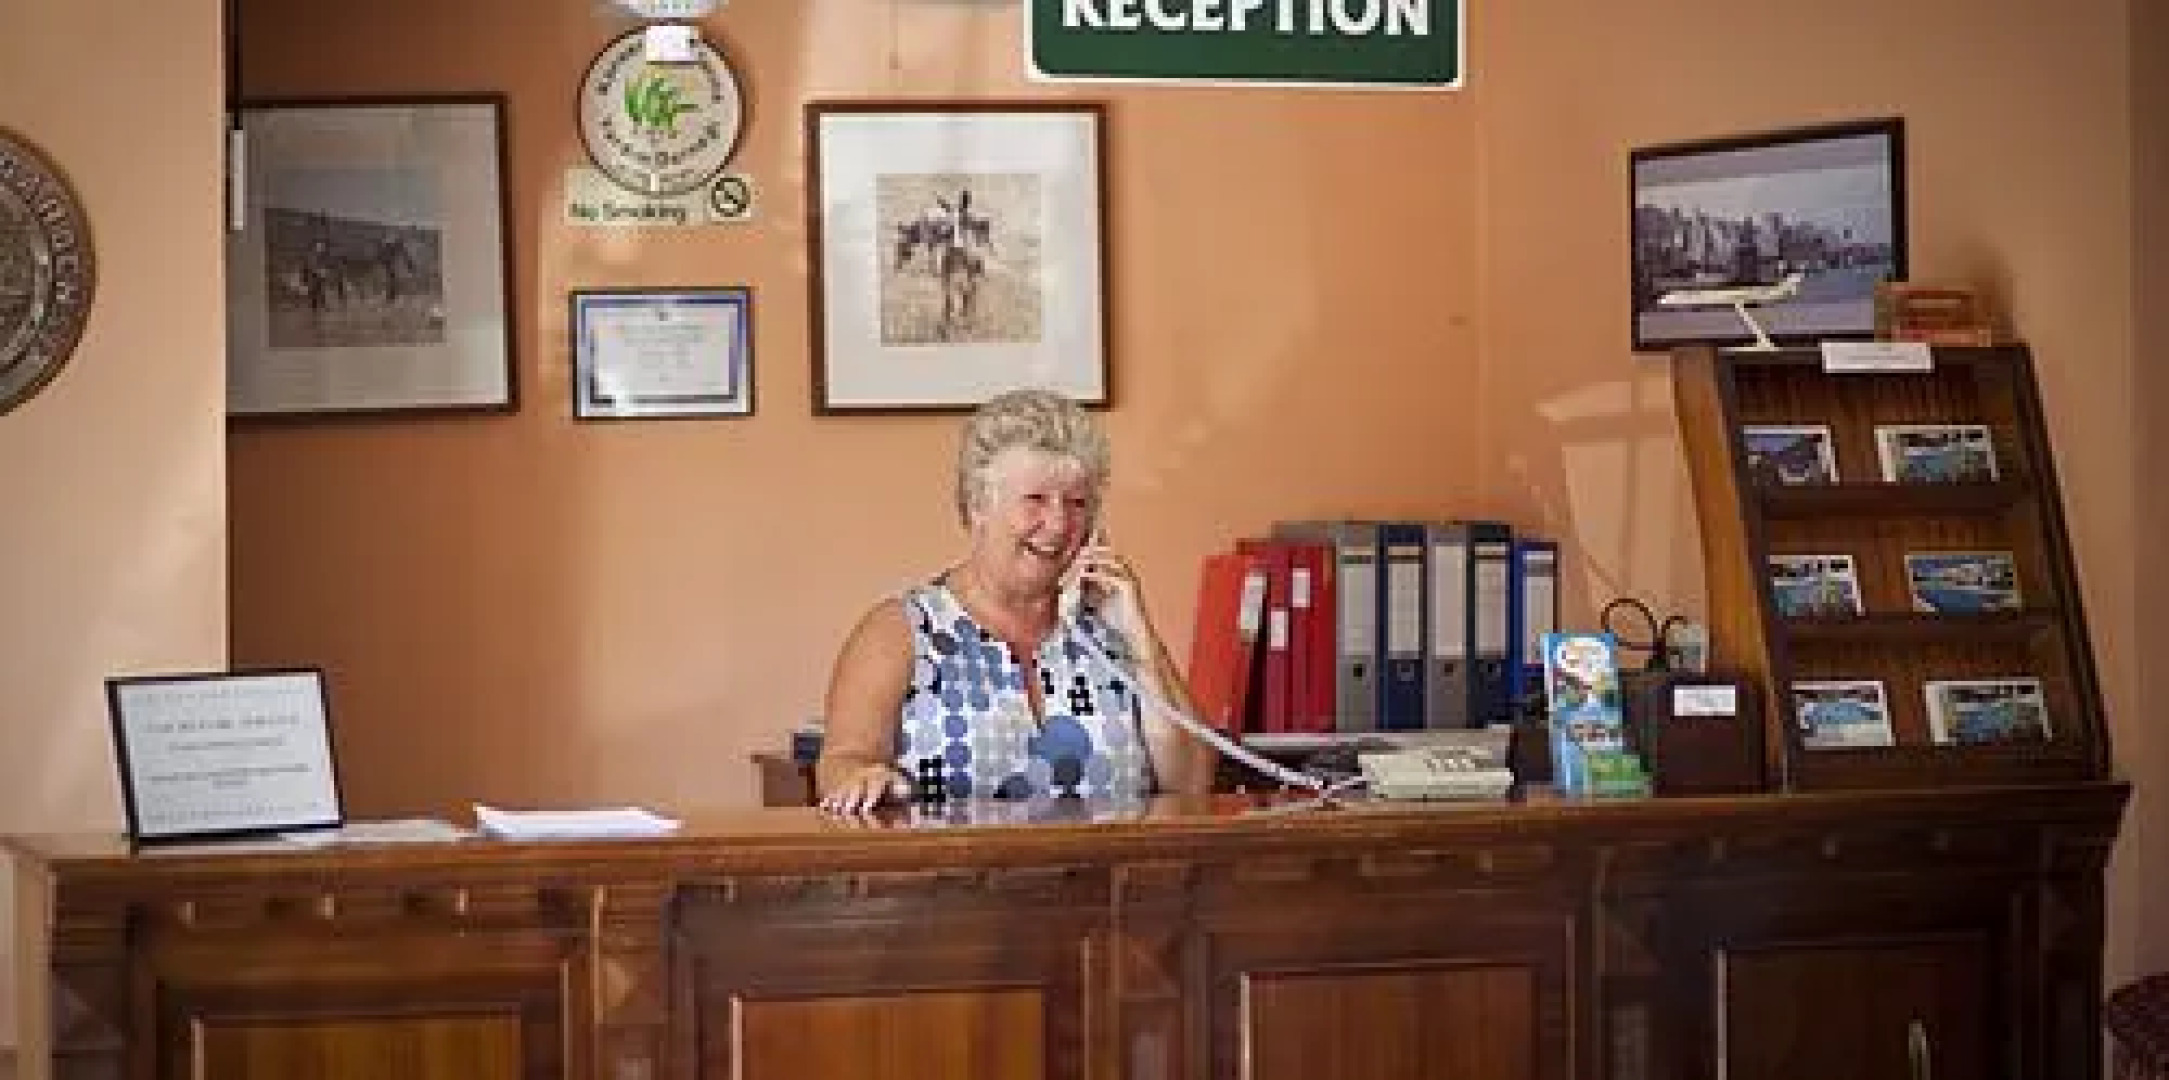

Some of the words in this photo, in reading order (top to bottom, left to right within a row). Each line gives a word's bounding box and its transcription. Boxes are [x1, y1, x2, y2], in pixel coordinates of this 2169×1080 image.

[1061, 0, 1431, 36] RECEPTION
[567, 202, 599, 221] No
[601, 202, 687, 226] Smoking
